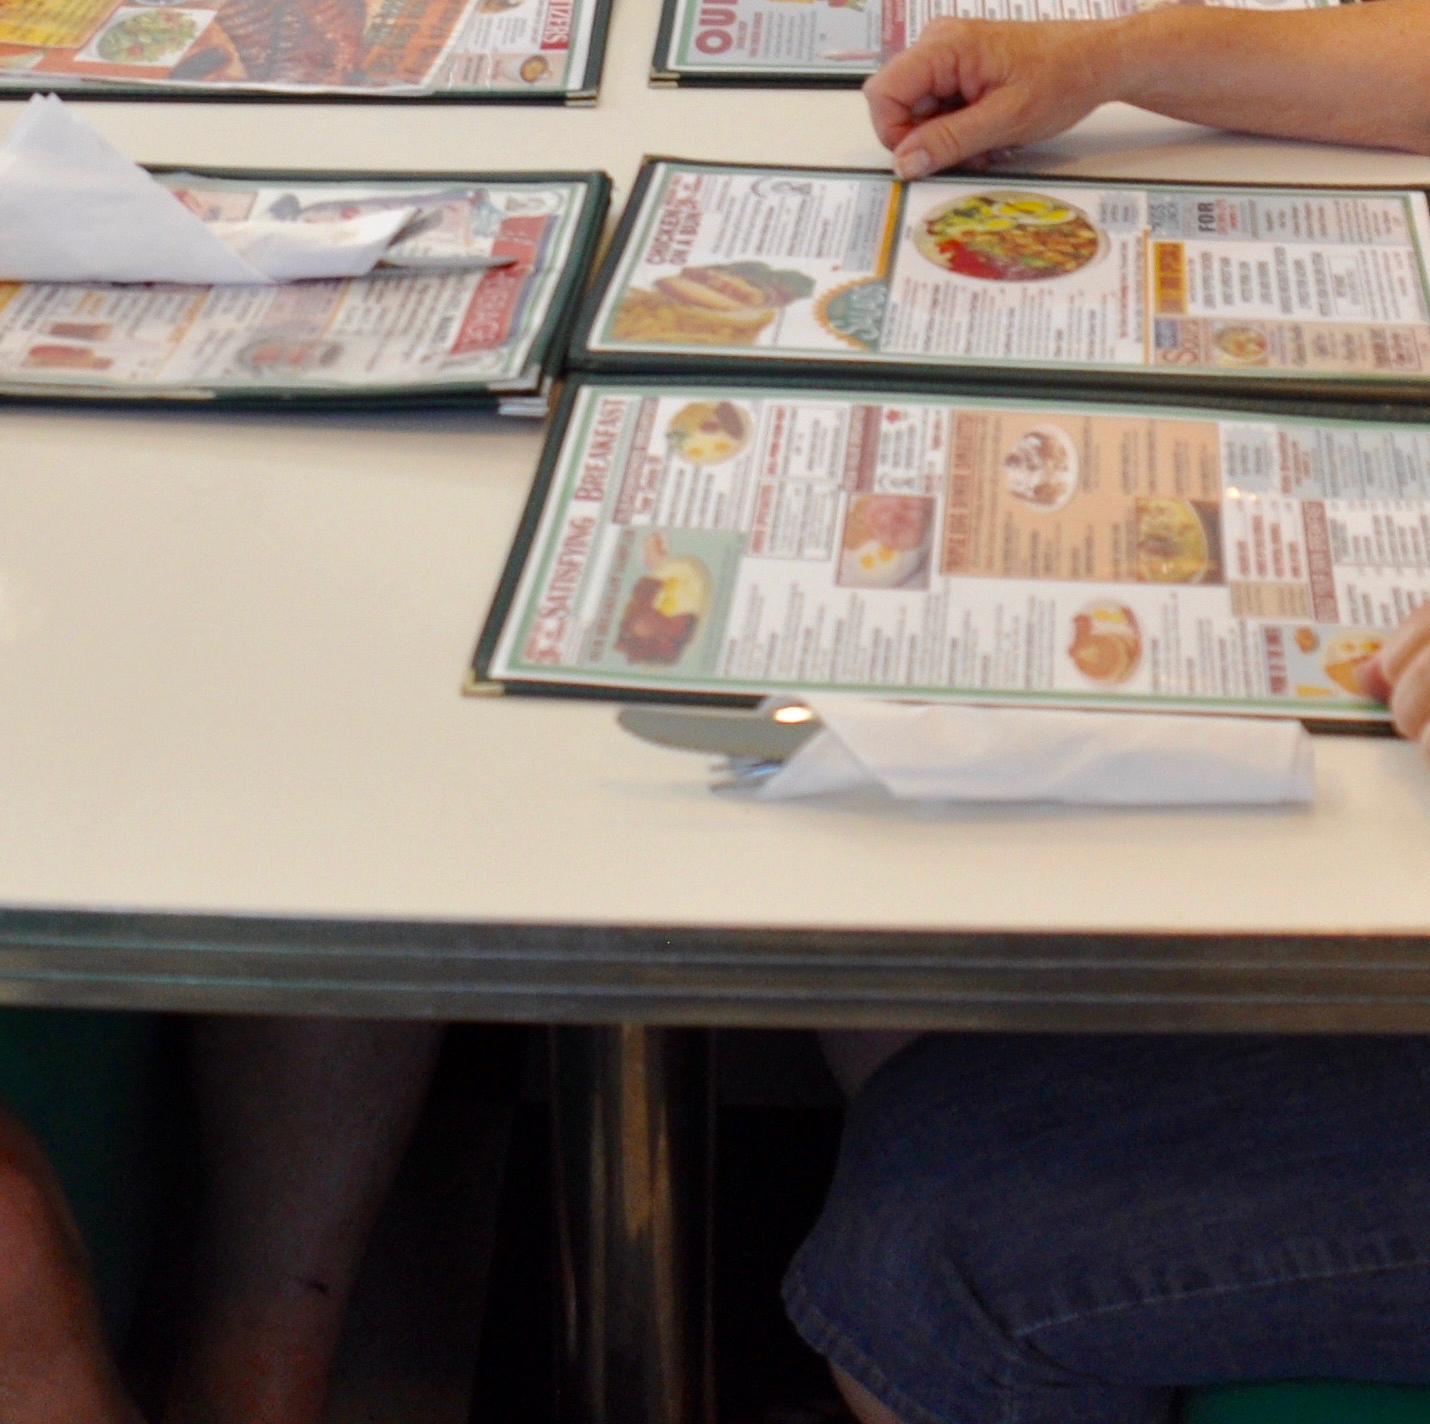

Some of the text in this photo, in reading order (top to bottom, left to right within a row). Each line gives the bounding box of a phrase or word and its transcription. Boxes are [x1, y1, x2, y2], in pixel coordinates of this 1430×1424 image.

[1198, 202, 1215, 233] FOR
[540, 517, 594, 622] SATISFYING
[572, 398, 627, 502] BREAKFAST
